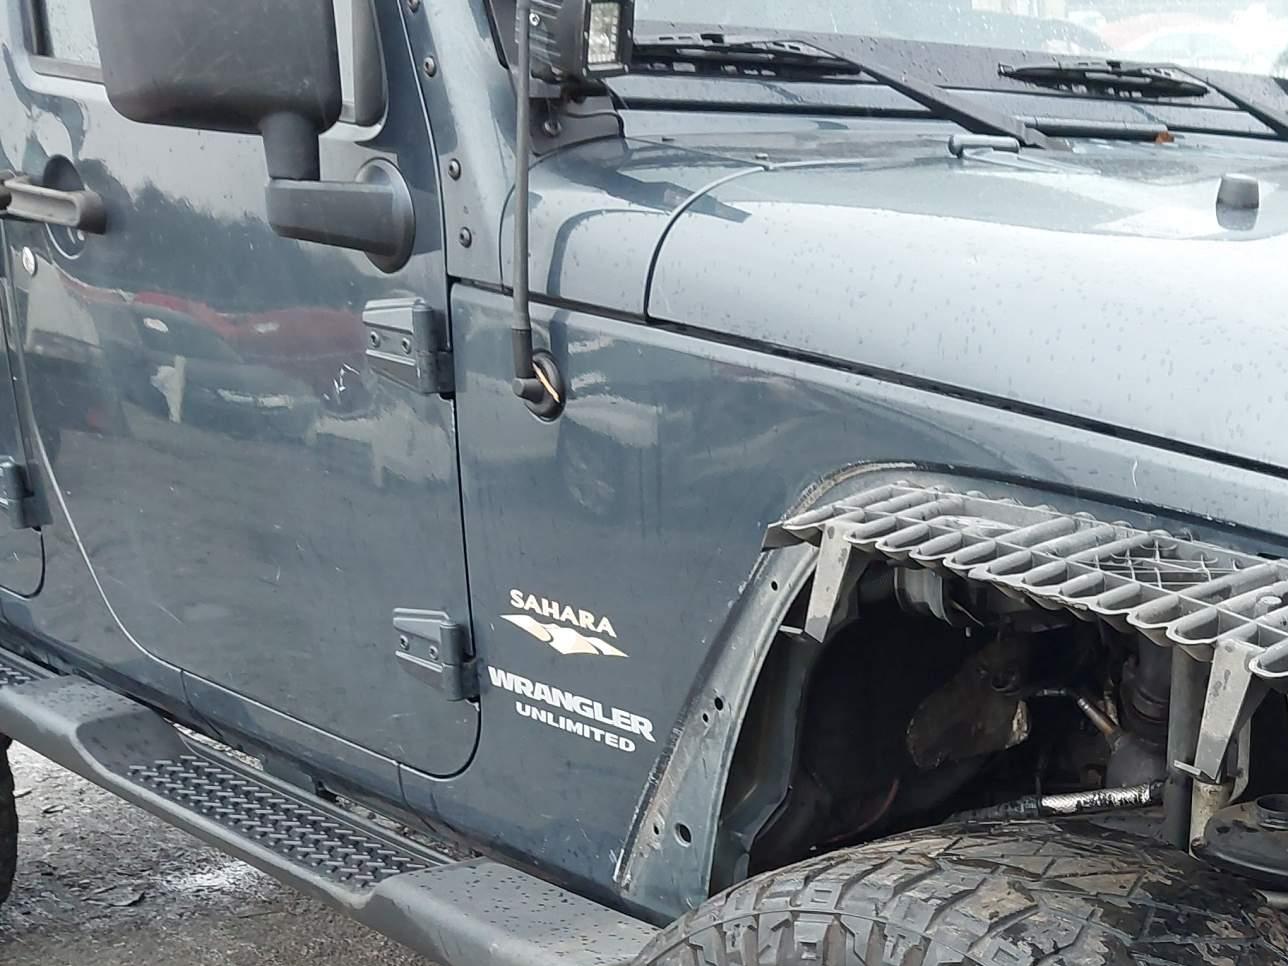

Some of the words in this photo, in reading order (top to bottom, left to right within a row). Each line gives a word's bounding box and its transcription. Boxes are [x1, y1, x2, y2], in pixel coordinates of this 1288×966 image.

[510, 589, 617, 638] SAHARA
[488, 666, 656, 743] WRANGLER
[515, 701, 636, 752] UNLIMITED
